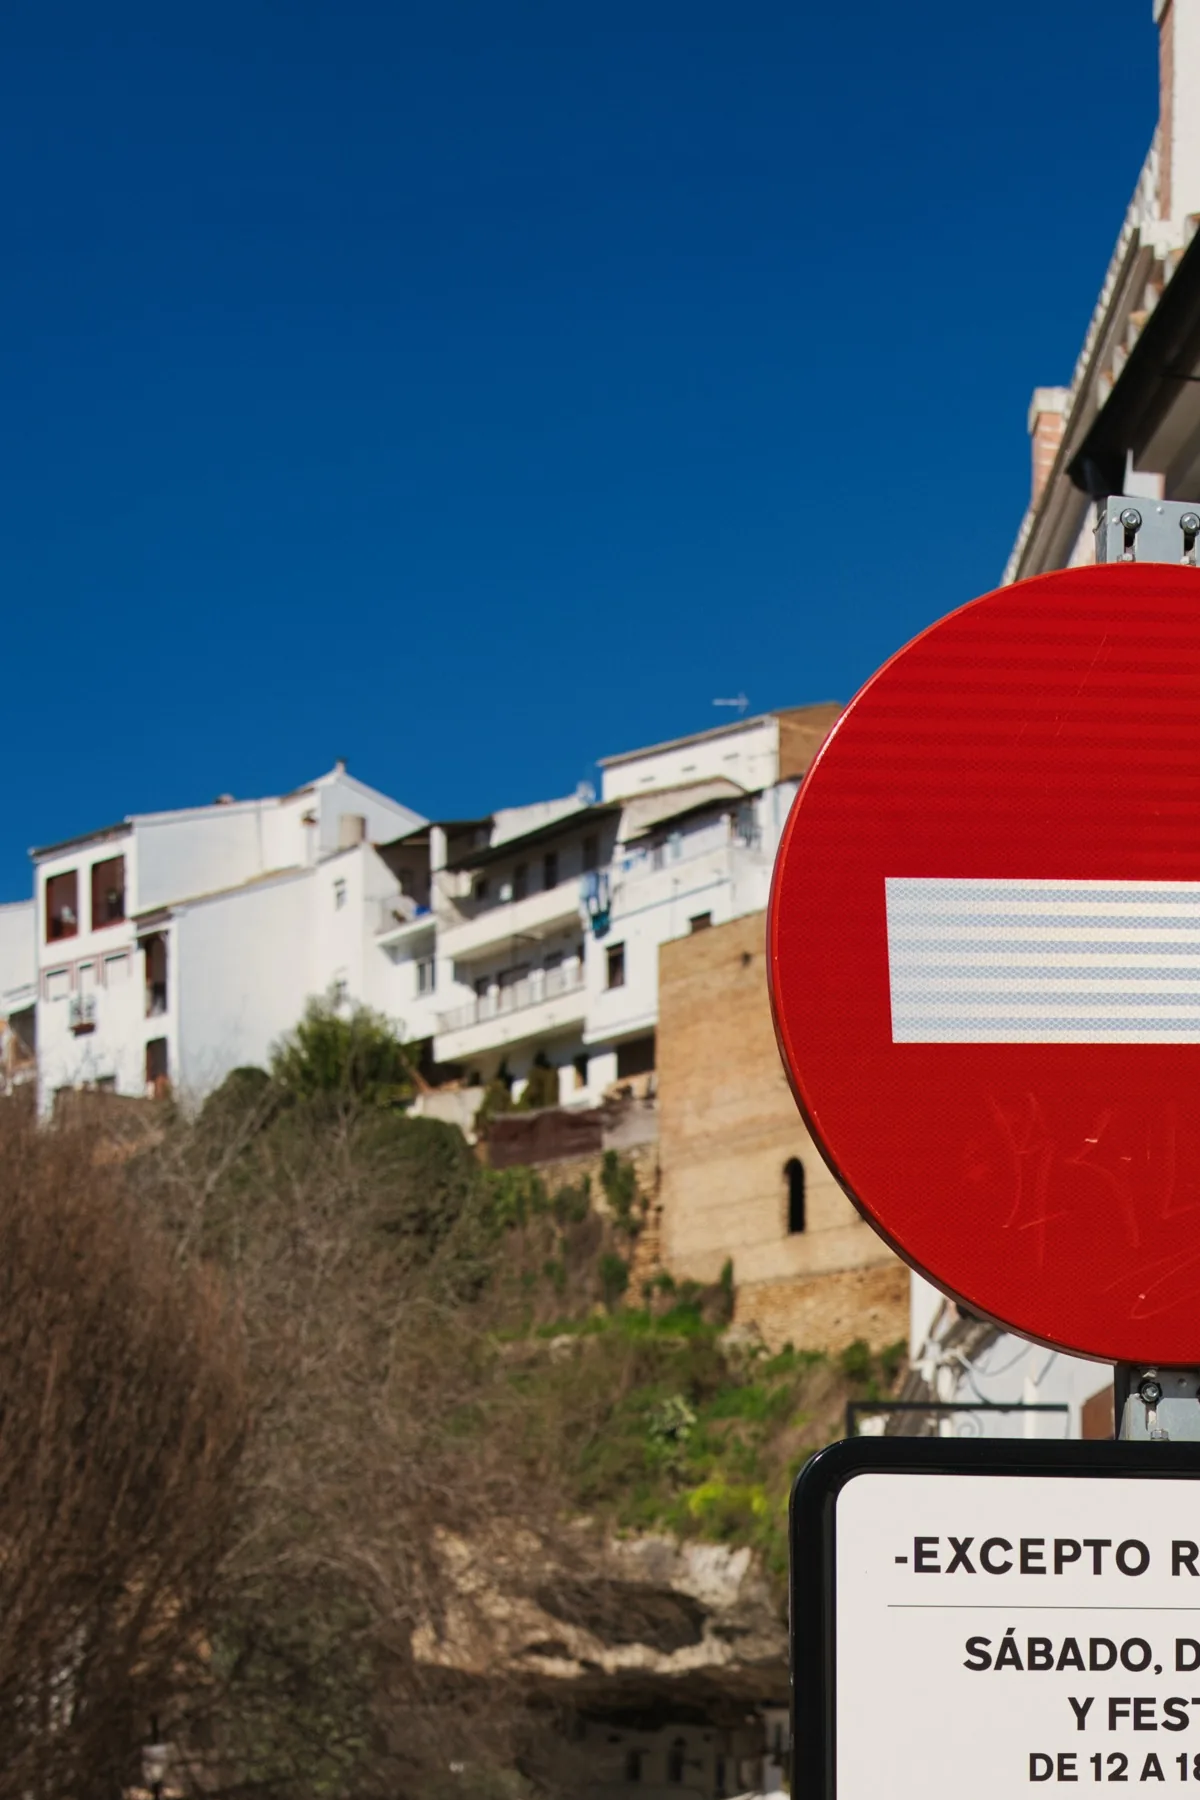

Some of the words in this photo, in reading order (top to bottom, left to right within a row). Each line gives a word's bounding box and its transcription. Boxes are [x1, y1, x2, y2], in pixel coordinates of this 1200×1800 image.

[894, 1536, 1151, 1577] -EXCEPTO
[963, 1627, 1163, 1675] SÁBADO,
[1067, 1696, 1095, 1731] Y
[1029, 1752, 1079, 1782] DE
[1089, 1751, 1129, 1782] 12
[1139, 1752, 1166, 1782] A
